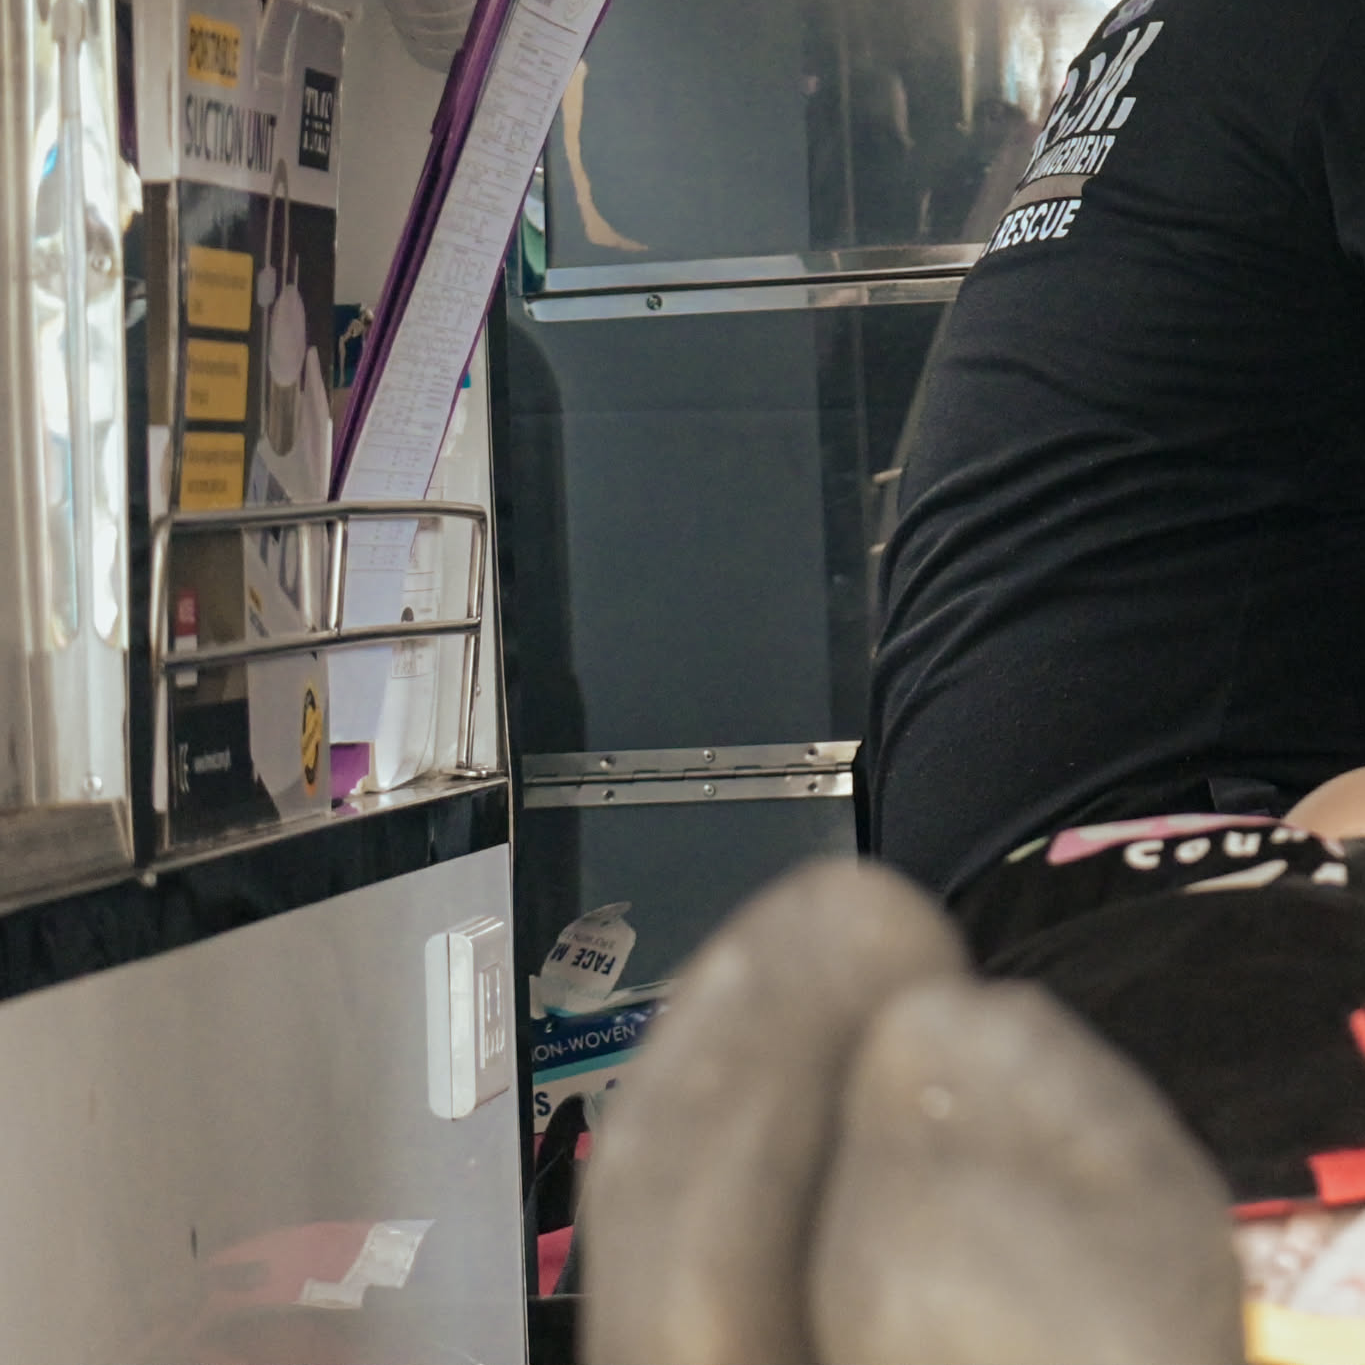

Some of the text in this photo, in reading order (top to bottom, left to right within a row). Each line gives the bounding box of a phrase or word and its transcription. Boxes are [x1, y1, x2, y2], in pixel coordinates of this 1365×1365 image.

[185, 92, 243, 168] SUCTION
[246, 110, 278, 174] UNIT
[988, 199, 1082, 254] RESCUE
[571, 947, 616, 976] FACE
[532, 1023, 636, 1063] ON-WOVEN
